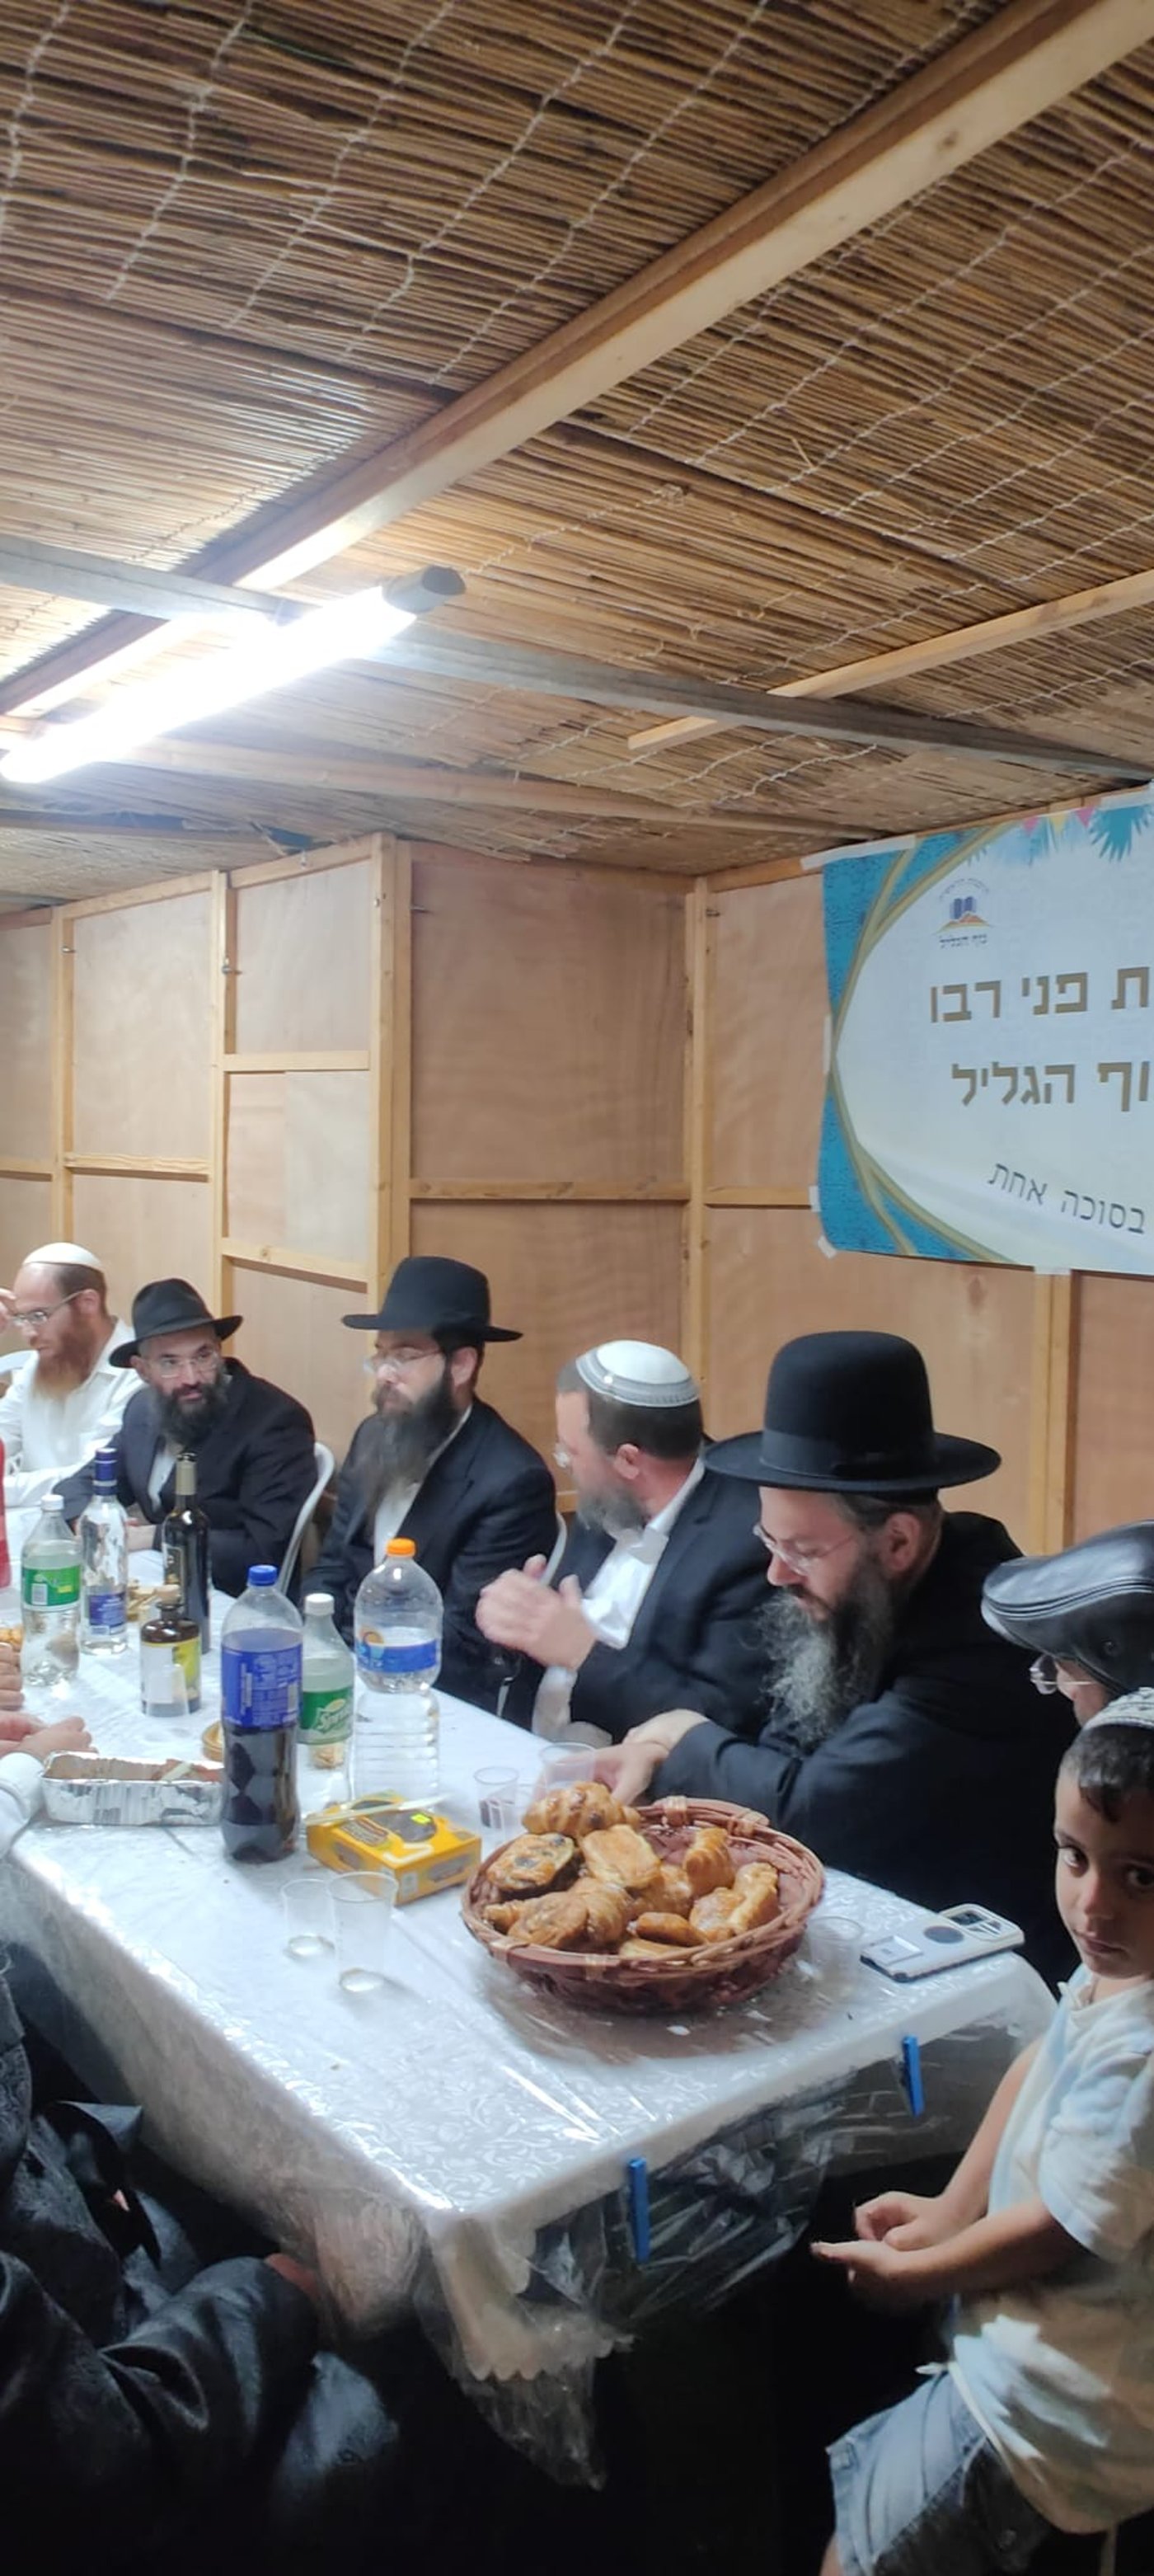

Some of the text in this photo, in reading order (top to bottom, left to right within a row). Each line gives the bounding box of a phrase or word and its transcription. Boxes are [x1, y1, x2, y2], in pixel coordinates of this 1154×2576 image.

[930, 966, 1150, 1023] ת פני רבו
[951, 1060, 1150, 1112] וף הגליל
[987, 1163, 1145, 1234] בסוכה אחת
